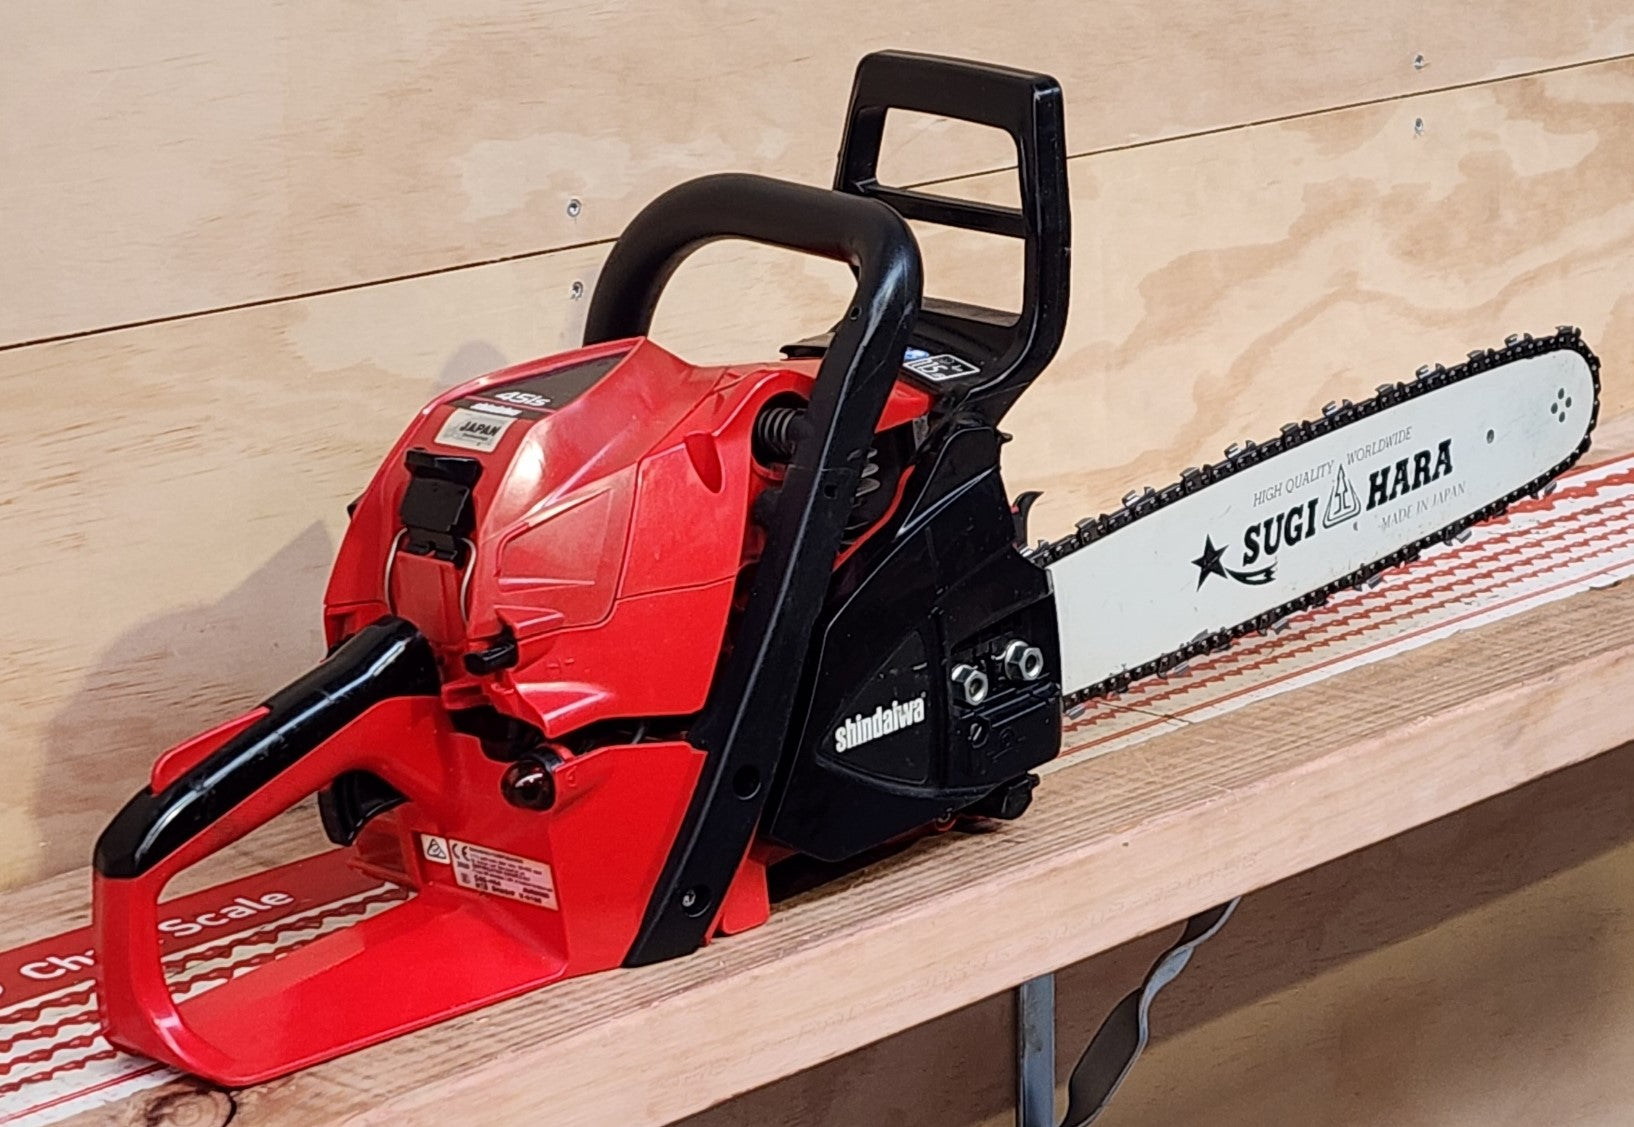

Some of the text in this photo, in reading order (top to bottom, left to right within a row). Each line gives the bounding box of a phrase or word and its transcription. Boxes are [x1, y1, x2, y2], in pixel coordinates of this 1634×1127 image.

[459, 421, 501, 436] JAPAN
[1253, 426, 1413, 507] HIGH QUALITY WORLDWIDE
[1242, 438, 1454, 567] SUGI HARA
[1381, 481, 1467, 531] MADE IN JAPAN
[834, 697, 926, 753] shindaiwa
[20, 890, 296, 980] Ch Scale
